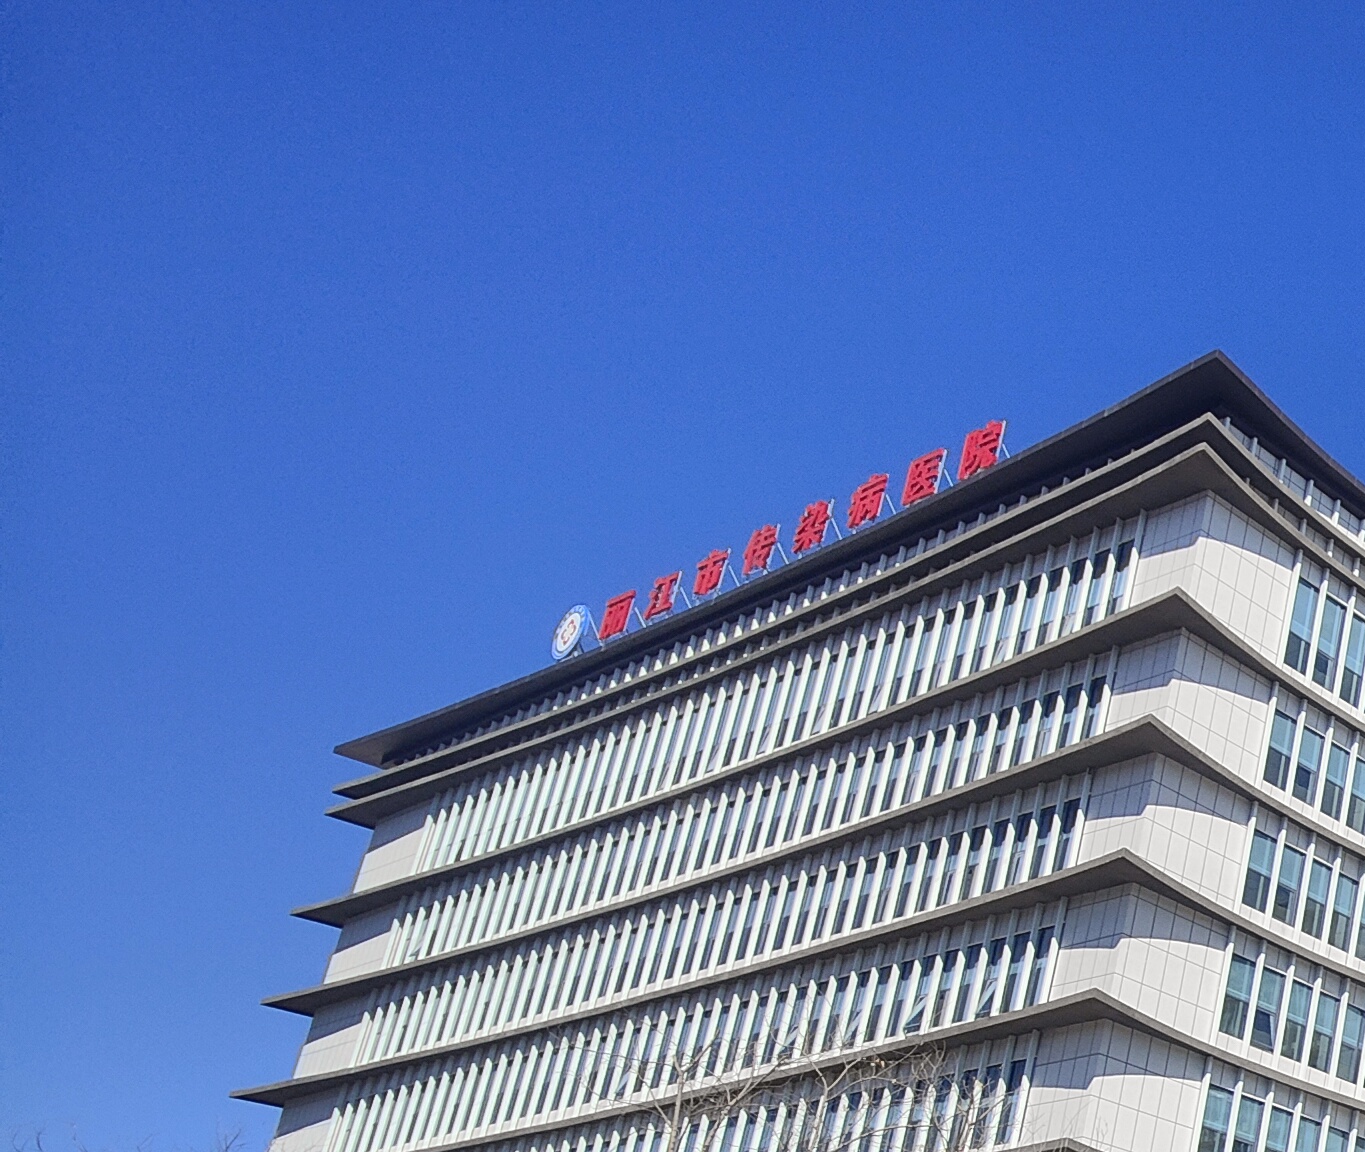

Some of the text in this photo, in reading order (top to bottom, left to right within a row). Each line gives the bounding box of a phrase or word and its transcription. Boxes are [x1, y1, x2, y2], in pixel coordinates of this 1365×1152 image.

[599, 420, 1004, 639] 丽江市传染病医院
